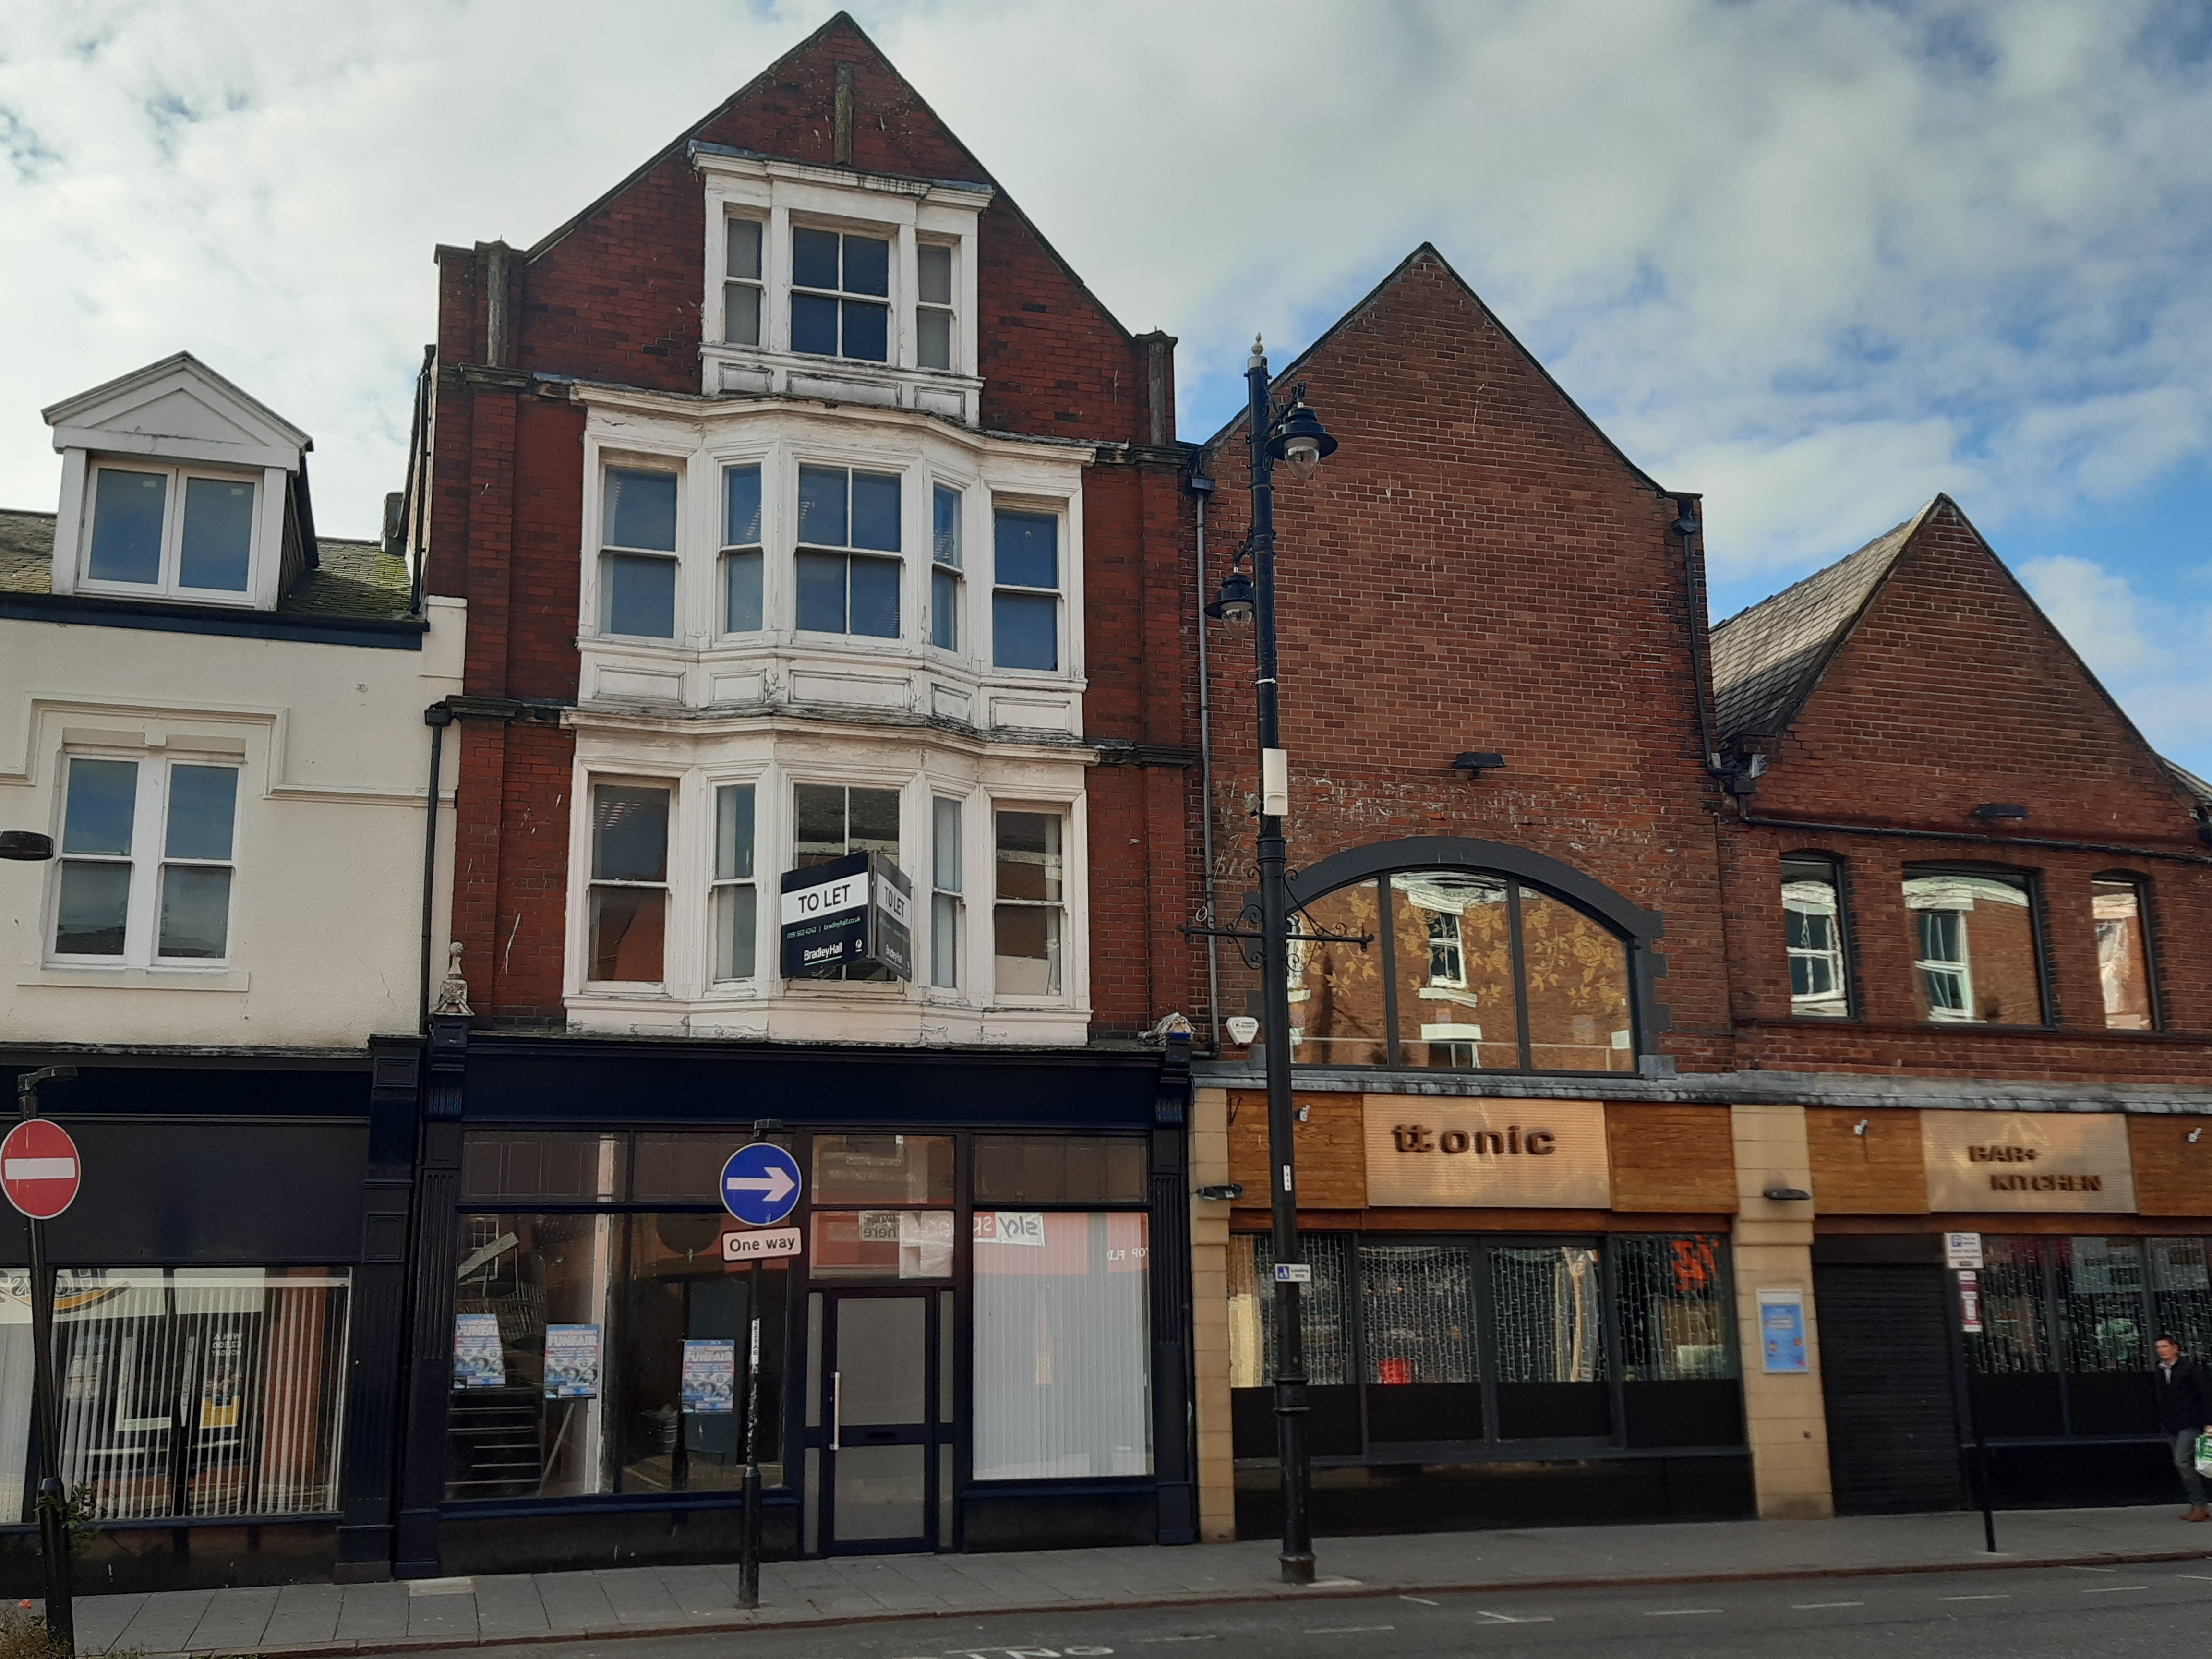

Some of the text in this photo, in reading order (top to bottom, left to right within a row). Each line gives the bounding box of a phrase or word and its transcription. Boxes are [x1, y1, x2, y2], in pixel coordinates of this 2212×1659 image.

[798, 884, 851, 914] TO LET
[885, 885, 905, 918] TO LET
[824, 915, 861, 930] bradleyhall.co.uk
[1990, 1174, 2102, 1191] KITCHEN
[730, 1237, 795, 1252] One way
[548, 1335, 597, 1346] FUNFAIR
[687, 1351, 733, 1361] FUNFAIR
